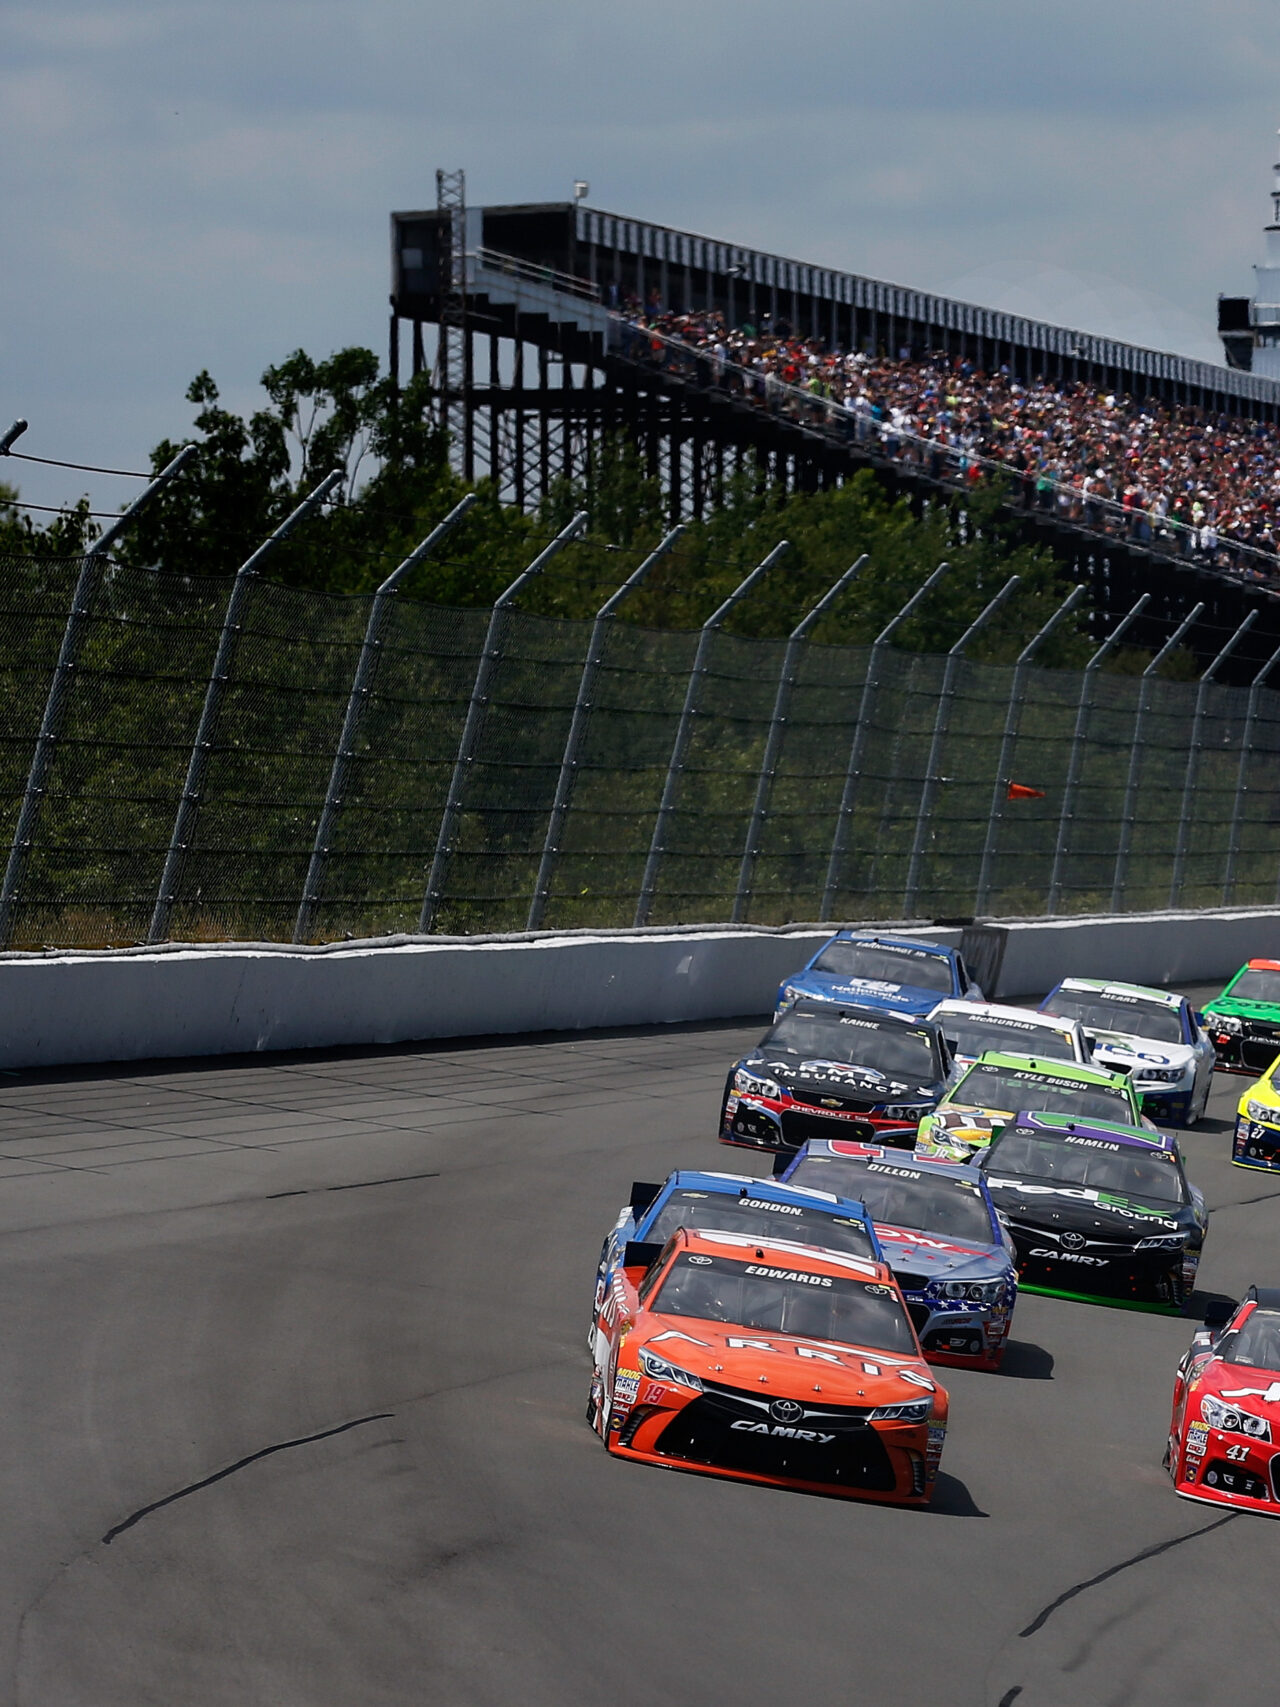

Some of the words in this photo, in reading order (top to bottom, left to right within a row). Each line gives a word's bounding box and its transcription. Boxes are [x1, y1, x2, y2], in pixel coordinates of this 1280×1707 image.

[831, 985, 910, 1003] Nationwide
[1100, 993, 1138, 1004] MEARS
[840, 1017, 880, 1030] KAHNE
[968, 1014, 1037, 1031] McMURRAY
[746, 1058, 935, 1097] FARMERS
[774, 1068, 902, 1095] INSURANCE
[1013, 1071, 1045, 1083] KYLE
[1047, 1077, 1089, 1090] BUSCH
[790, 1104, 851, 1120] CHEVROLET
[1064, 1135, 1120, 1151] HAMLIN
[1250, 1128, 1266, 1140] 27
[867, 1162, 921, 1180] DILLON
[987, 1177, 1173, 1219] FedEx
[1093, 1201, 1178, 1230] Ground
[1029, 1248, 1110, 1267] CAMRY
[745, 1265, 833, 1288] EDWARDS
[617, 1367, 642, 1381] MOOG
[643, 1383, 667, 1405] 19
[730, 1420, 836, 1443] CAMRY
[1226, 1444, 1250, 1461] 41
